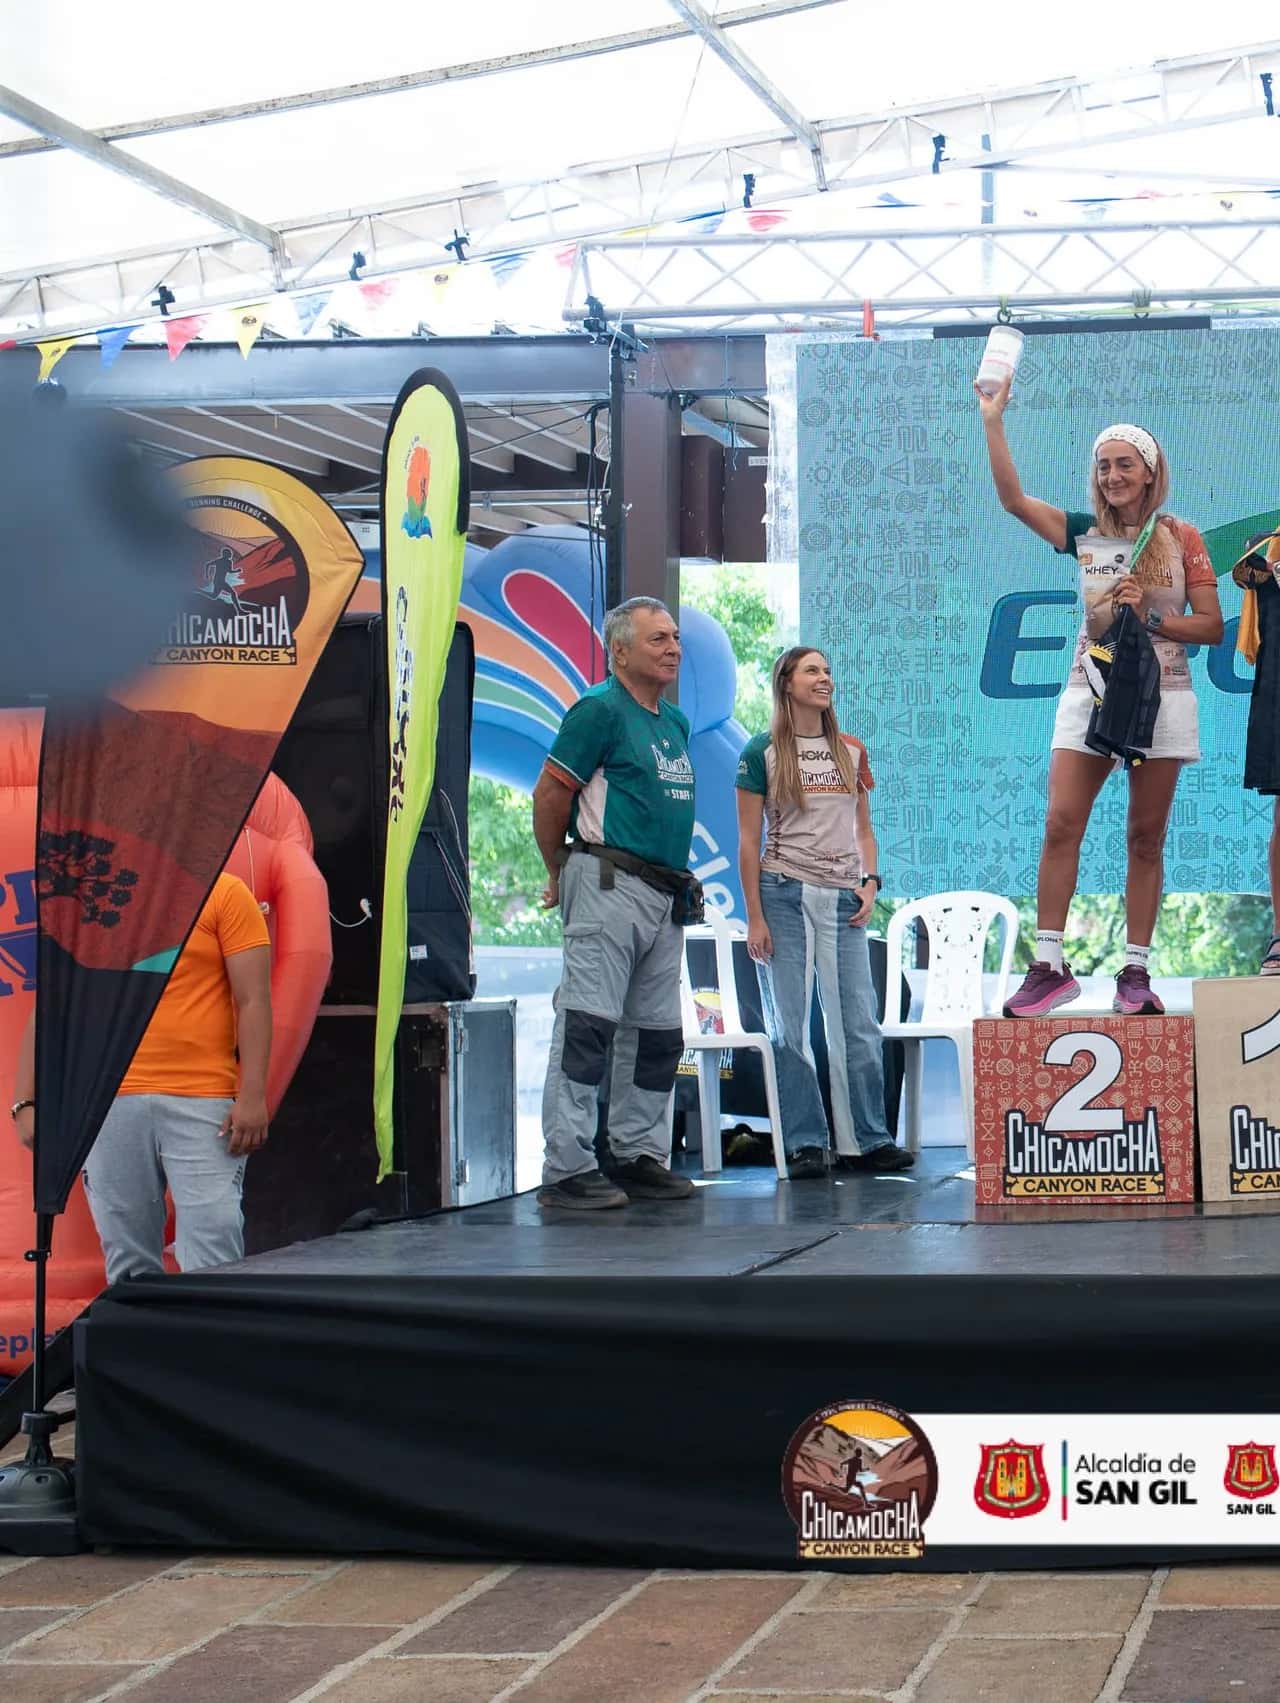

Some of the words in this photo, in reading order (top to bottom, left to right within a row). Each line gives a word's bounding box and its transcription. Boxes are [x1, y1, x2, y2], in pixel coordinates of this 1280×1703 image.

[223, 500, 262, 518] CHALLENGE
[1084, 565, 1119, 575] WHEY
[167, 648, 235, 662] CANYON
[238, 649, 280, 662] RACE
[1043, 1031, 1123, 1131] 2
[1008, 1110, 1160, 1174] CHICAMOCHA
[1023, 1178, 1097, 1193] CANYON
[1101, 1178, 1147, 1192] RACE
